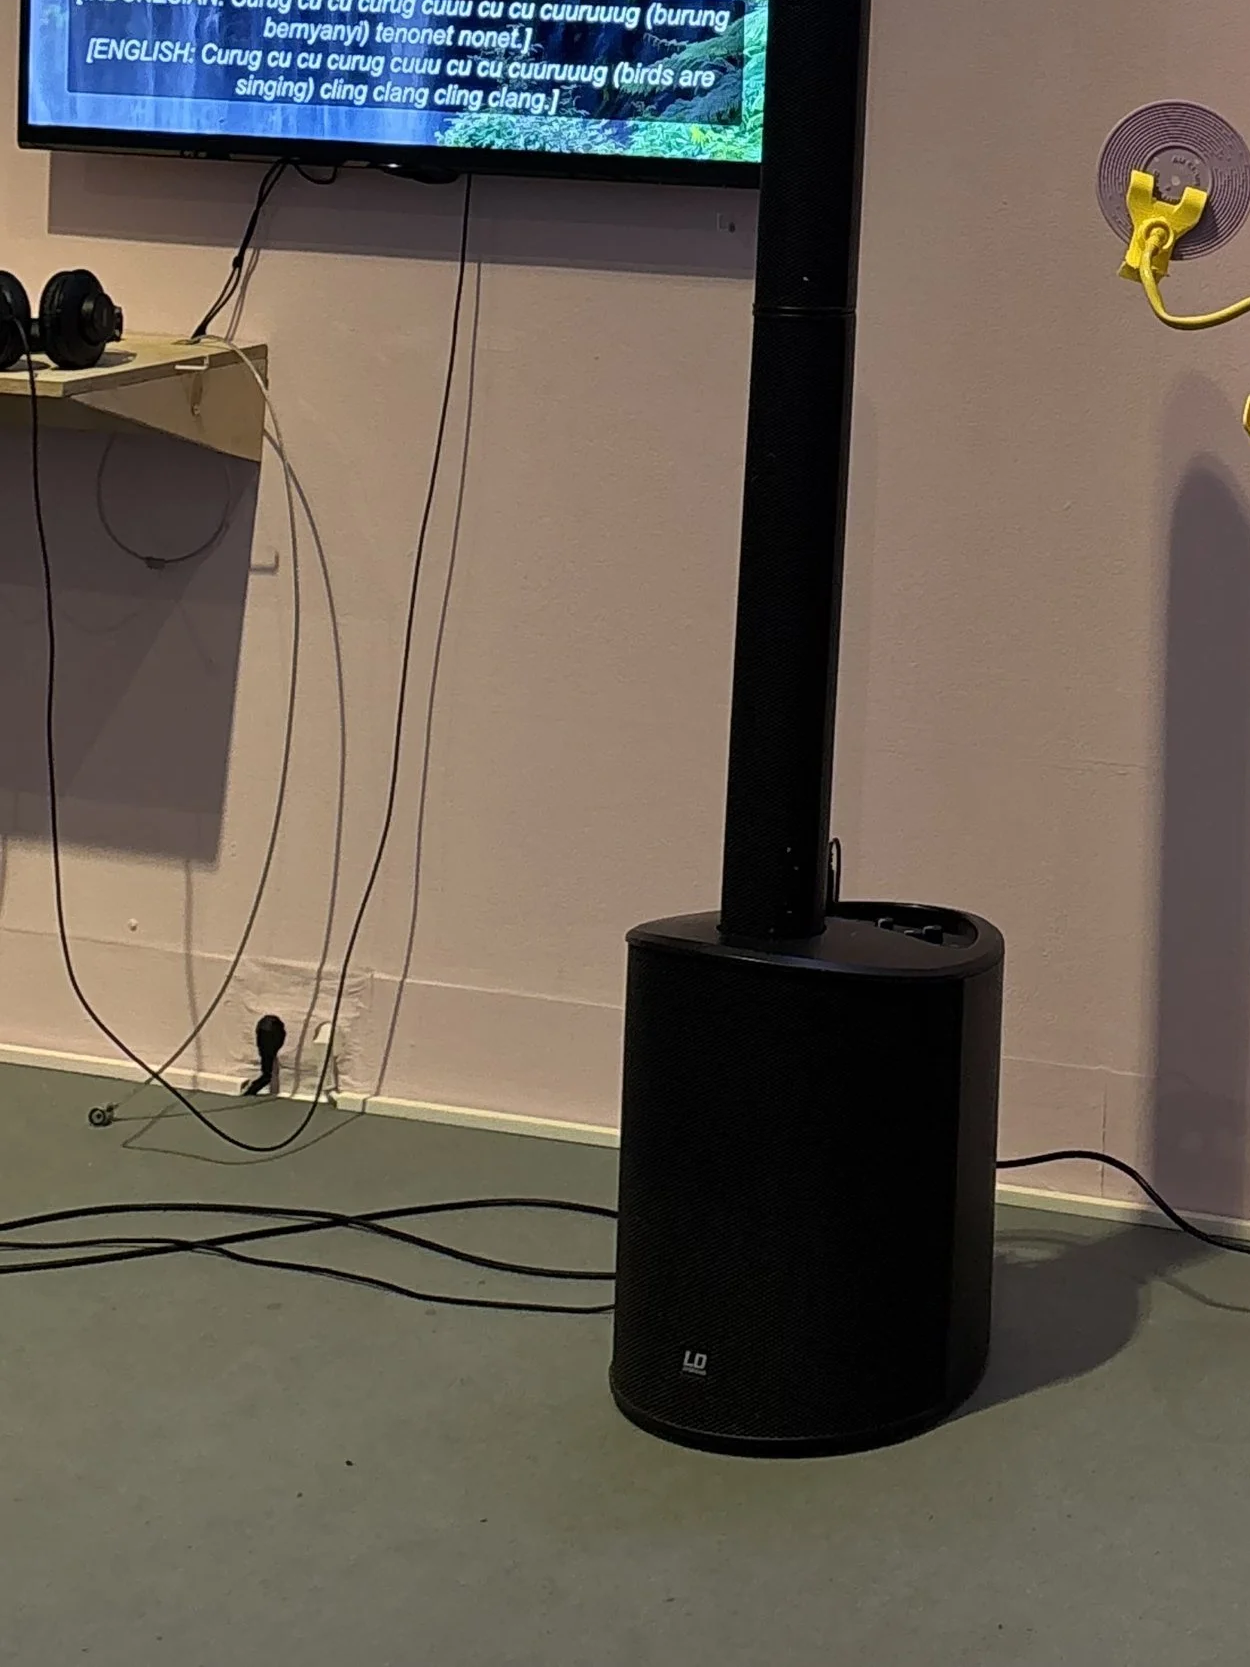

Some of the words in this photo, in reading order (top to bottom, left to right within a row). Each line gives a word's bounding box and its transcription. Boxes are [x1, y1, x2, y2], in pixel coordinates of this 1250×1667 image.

[477, 0, 503, 19] cu
[508, 1, 534, 21] cu
[539, 2, 641, 28] cuuruuug
[645, 2, 730, 33] (burung
[375, 23, 454, 46] tenonet
[457, 25, 533, 55] nonet.]
[86, 37, 196, 64] [ENGLISH:
[201, 42, 263, 71] Curug
[267, 49, 292, 69] cu
[296, 50, 322, 70] cu
[326, 52, 385, 77] curug
[390, 56, 441, 76] cuuu
[446, 57, 473, 77] cu
[476, 58, 502, 79] cu
[508, 60, 609, 88] cuuruuug
[612, 61, 674, 90] (birds
[678, 68, 716, 88] are
[235, 76, 315, 103] singing)
[319, 78, 369, 106] cling
[372, 82, 428, 109] clang
[433, 84, 484, 110] cling
[487, 86, 560, 115] clang.]
[682, 1349, 708, 1370] LD
